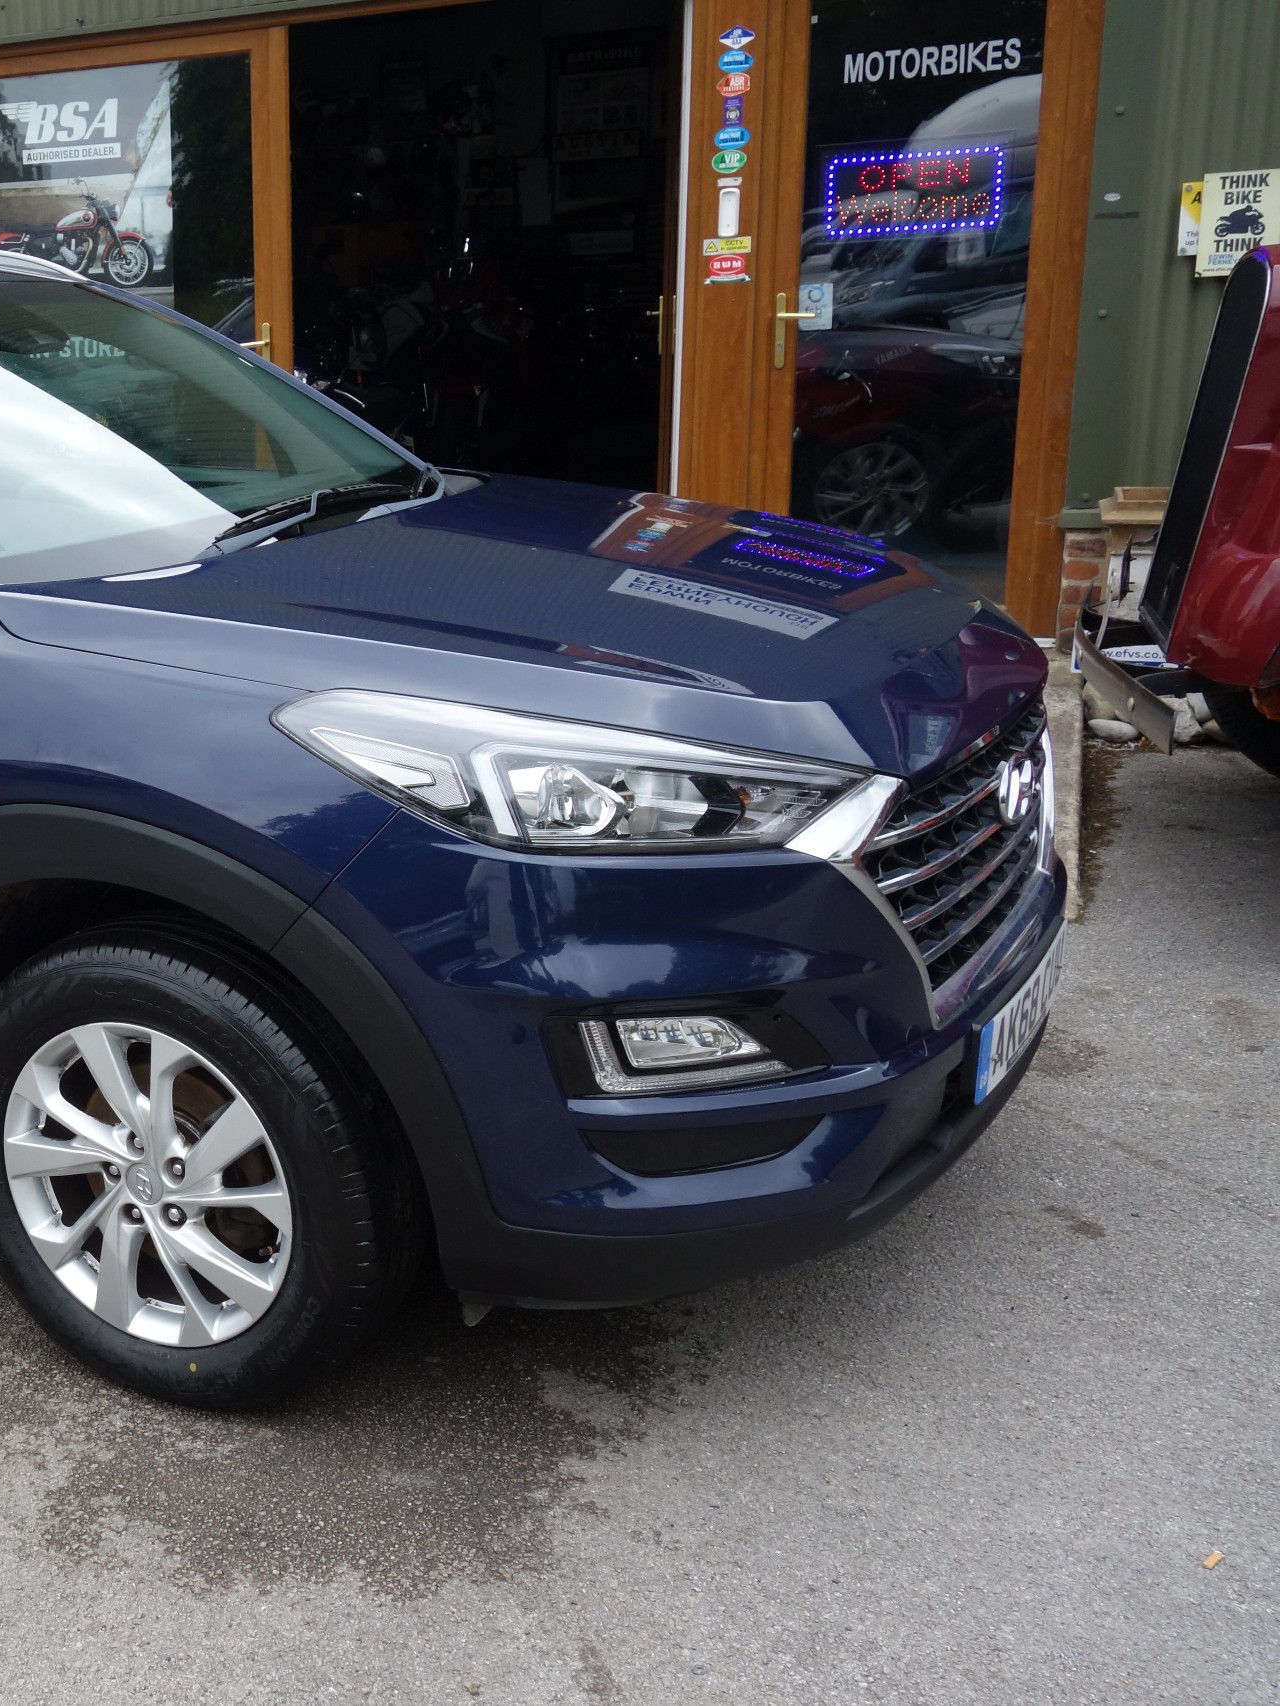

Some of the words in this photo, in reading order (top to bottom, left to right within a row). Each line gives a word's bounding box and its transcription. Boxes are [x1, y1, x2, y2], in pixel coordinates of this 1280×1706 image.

[844, 38, 1021, 84] MOTORBIKES
[25, 98, 118, 144] BSA
[555, 132, 637, 151] AUSTIN
[27, 149, 80, 162] AUTHORISED
[725, 153, 740, 163] VIP
[860, 157, 969, 190] OPEN
[1220, 173, 1271, 189] THINK
[1224, 190, 1263, 206] BIKE
[837, 191, 991, 226] Welcome
[1214, 237, 1263, 252] THINK
[874, 345, 912, 365] YAMAHA
[992, 975, 1041, 1077] AK68
